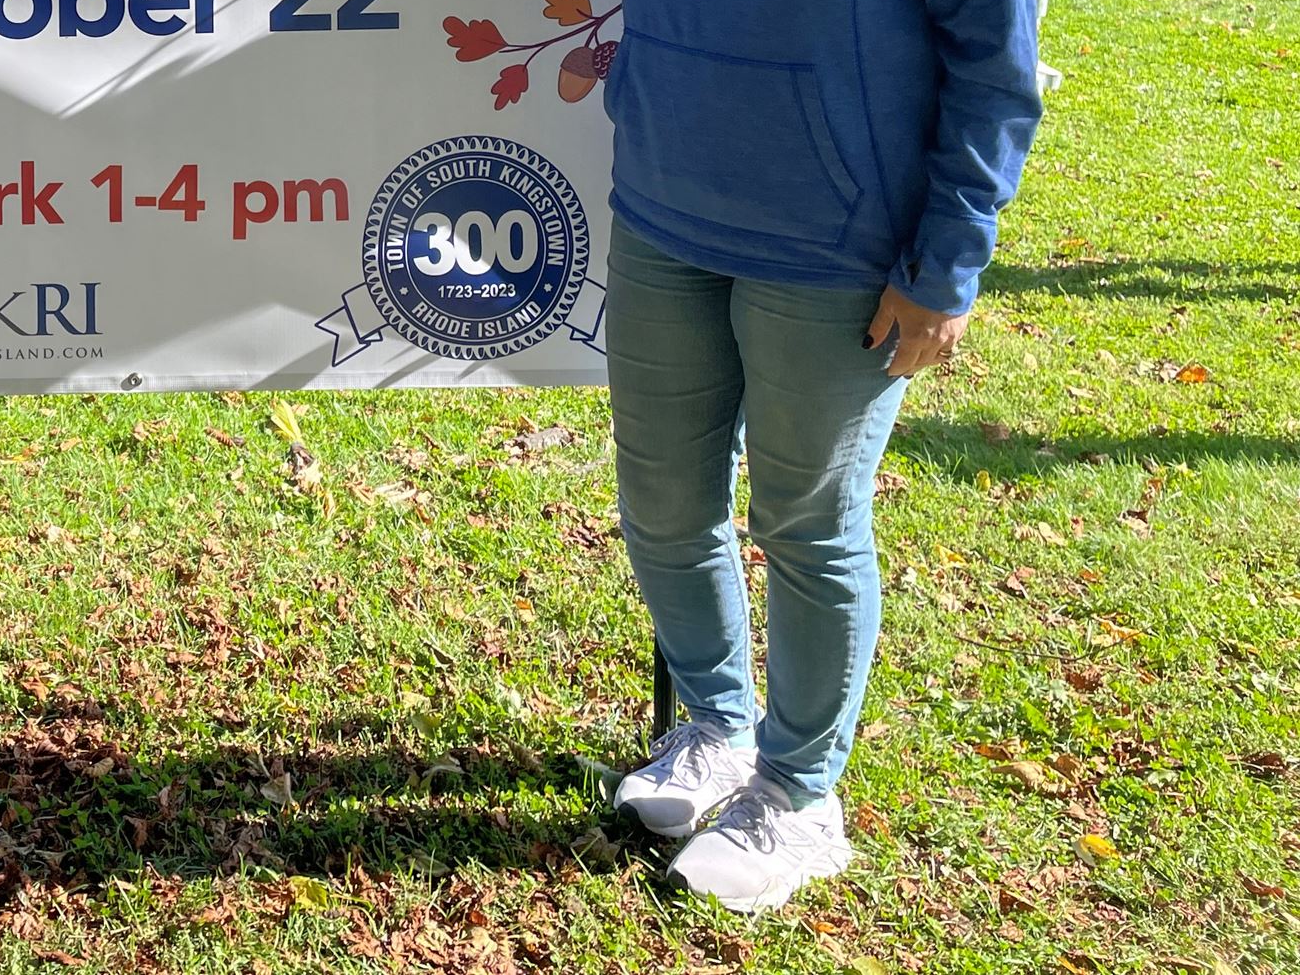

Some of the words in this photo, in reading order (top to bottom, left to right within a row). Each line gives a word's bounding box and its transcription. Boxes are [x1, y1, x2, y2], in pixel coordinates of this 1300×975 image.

[90, 163, 206, 223] 1-4
[232, 176, 350, 241] pm
[386, 214, 409, 273] TOWN
[402, 183, 426, 209] OF
[427, 159, 491, 188] SOUTH
[498, 164, 565, 267] KINGSTOWN
[412, 209, 539, 277] 300
[411, 300, 471, 338] RHODE
[477, 300, 542, 338] ISLAND
